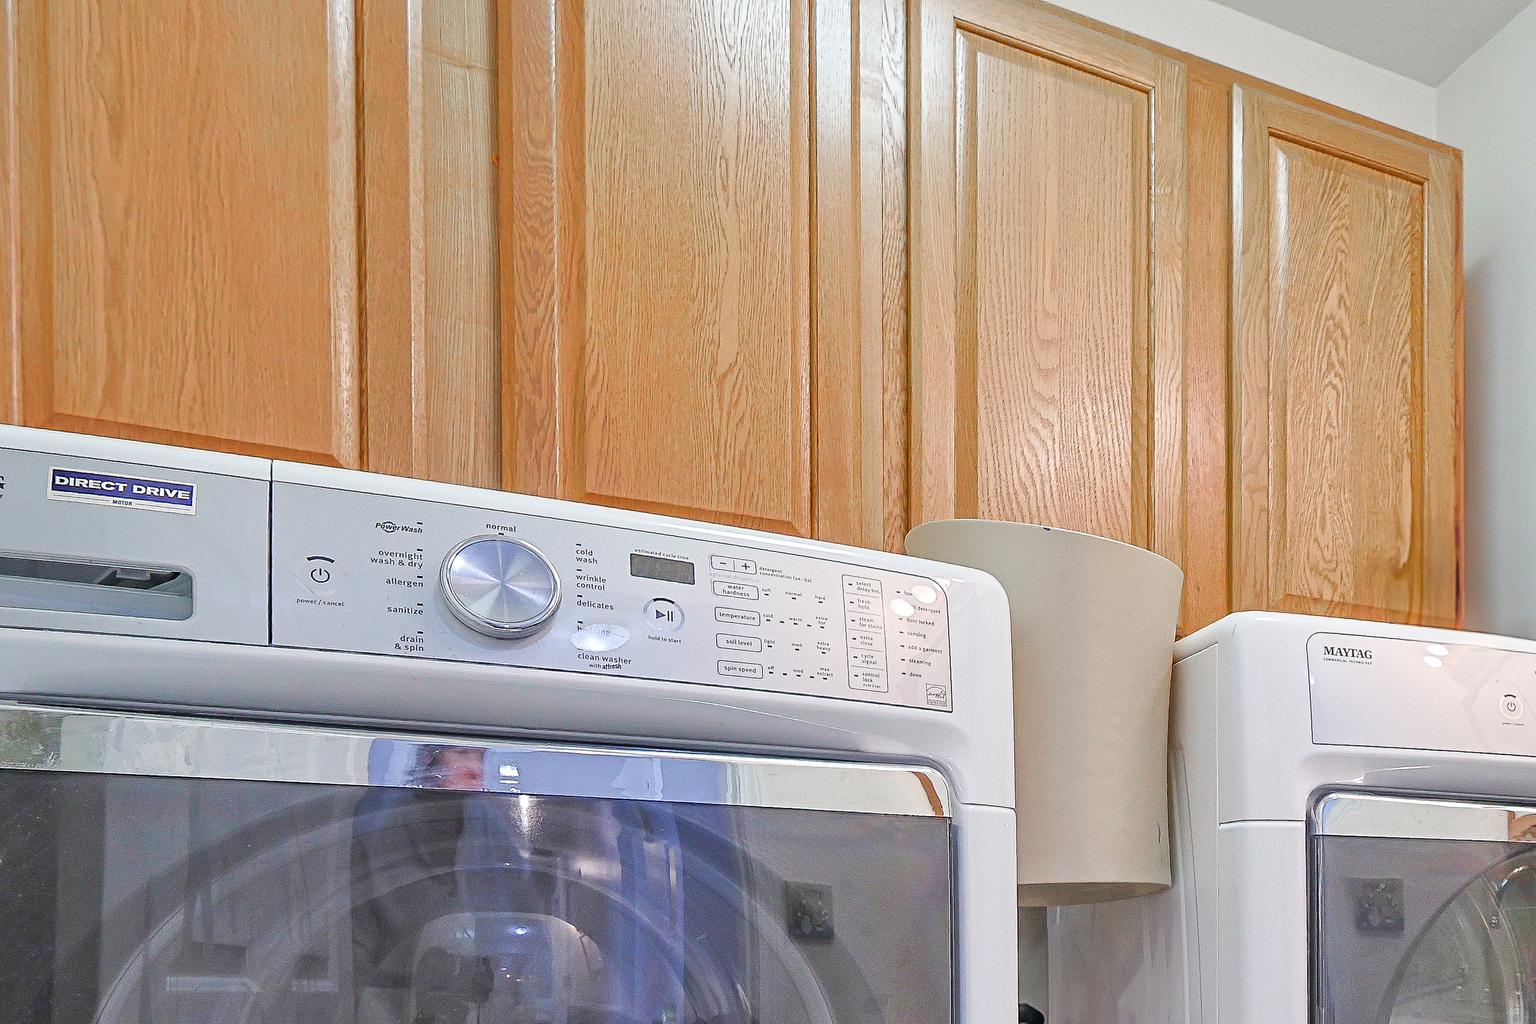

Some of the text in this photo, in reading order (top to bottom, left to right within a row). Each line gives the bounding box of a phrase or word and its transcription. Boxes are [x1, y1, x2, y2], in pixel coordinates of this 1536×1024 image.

[55, 476, 191, 499] DIRECT DRIVE
[486, 523, 516, 532] normal
[378, 549, 423, 560] overnight
[370, 557, 395, 565] wash
[407, 560, 423, 569] dry
[576, 556, 598, 564] wash
[386, 578, 424, 588] allergen
[576, 575, 606, 583] wrinkle
[576, 583, 605, 591] control
[722, 589, 750, 597] hardness
[577, 600, 614, 610] delicates
[387, 606, 424, 615] sanitize
[720, 612, 755, 621] temperature
[400, 634, 424, 644] drain
[404, 644, 424, 652] spin
[1323, 646, 1372, 659] MAYTAG
